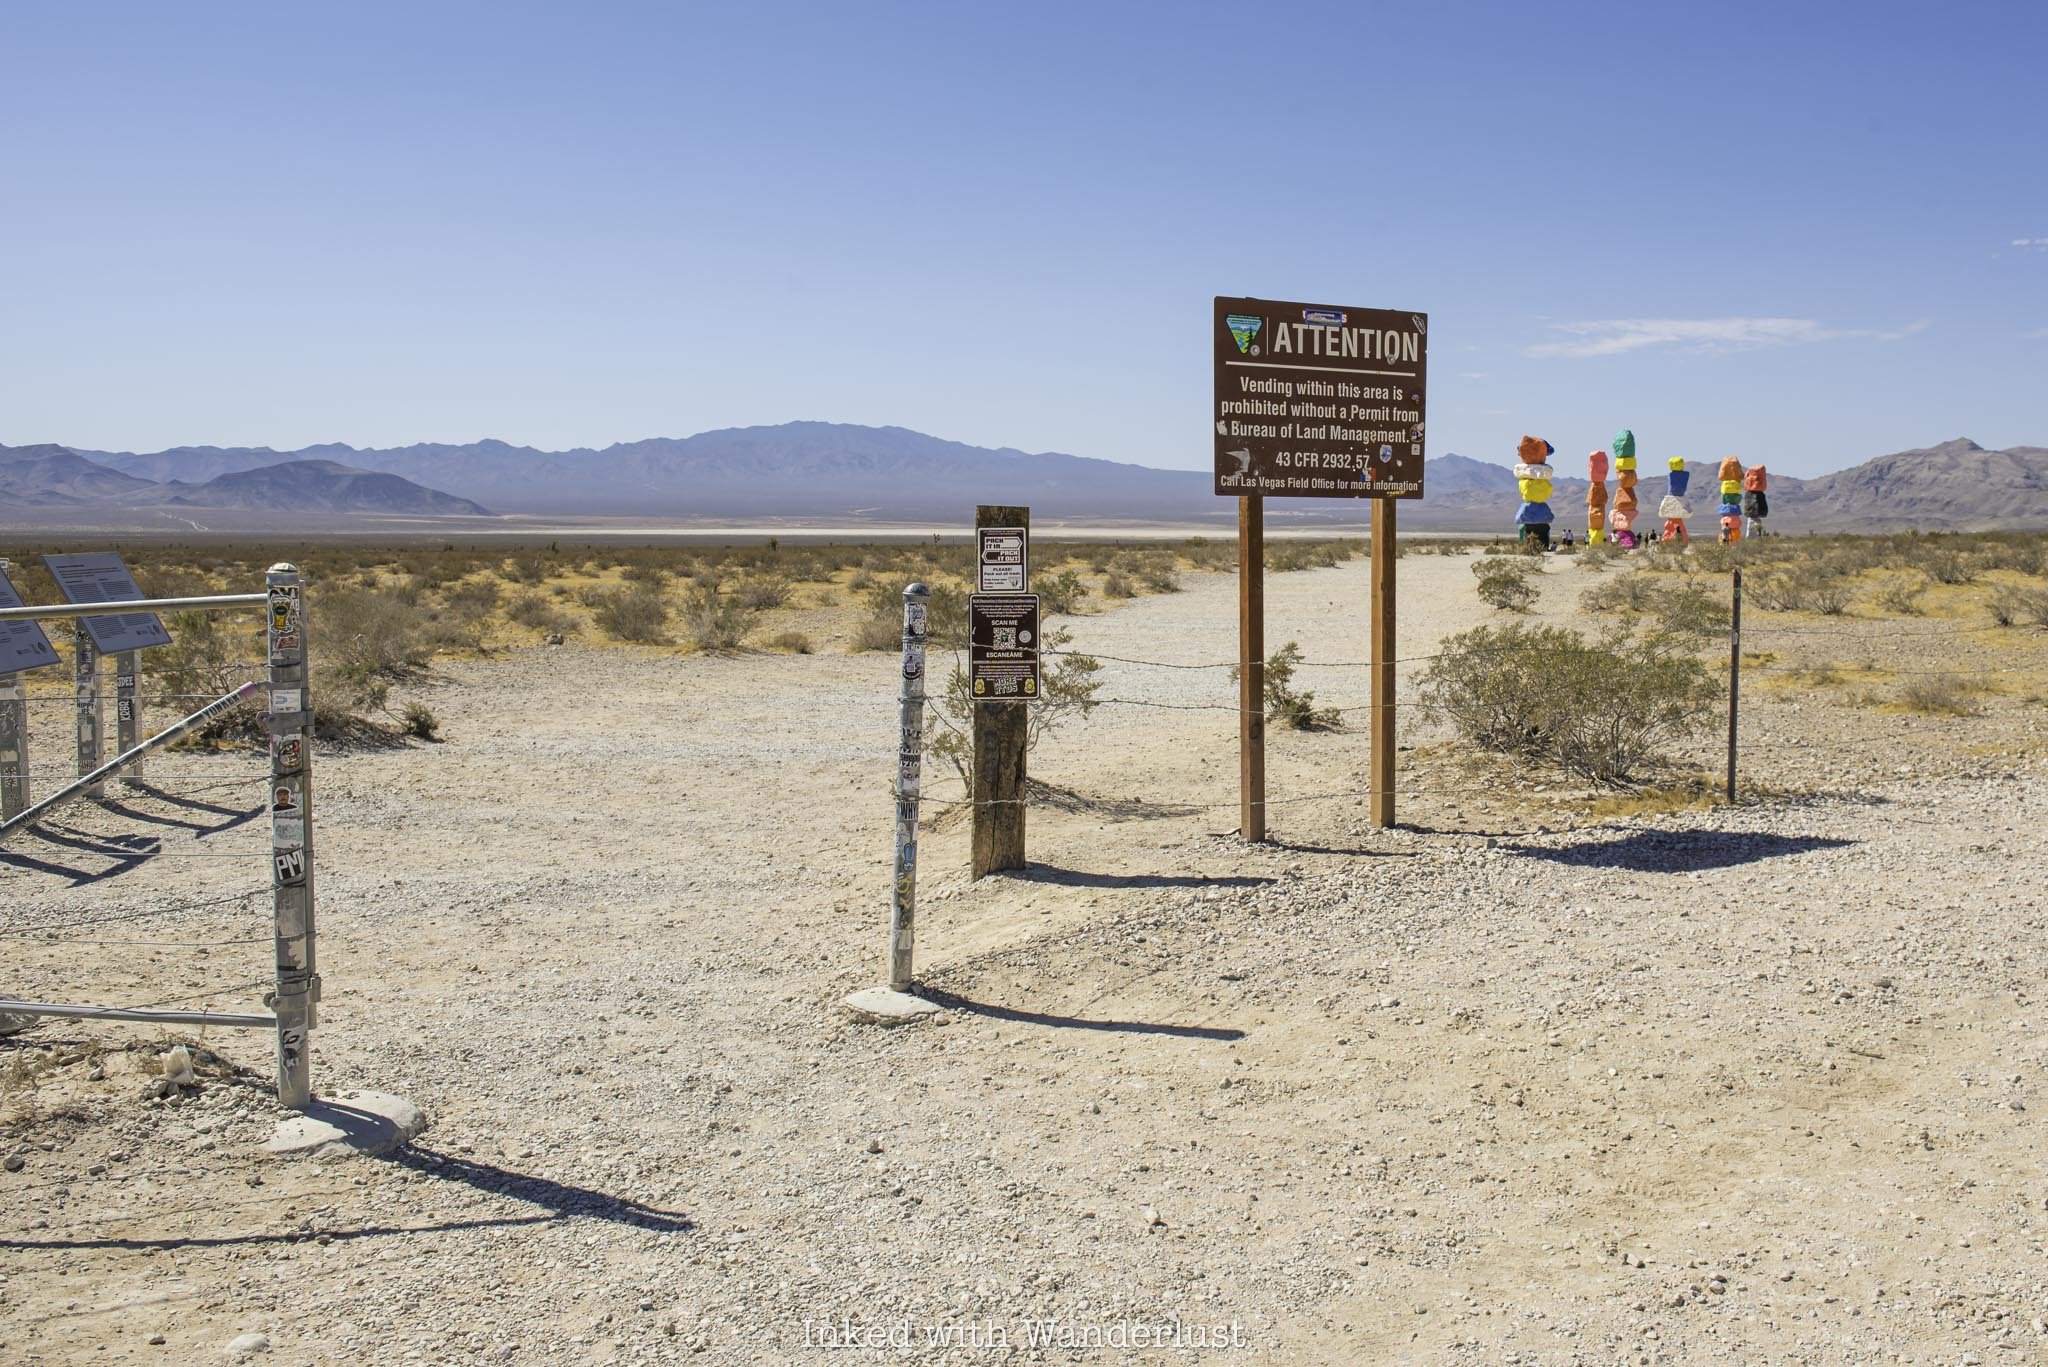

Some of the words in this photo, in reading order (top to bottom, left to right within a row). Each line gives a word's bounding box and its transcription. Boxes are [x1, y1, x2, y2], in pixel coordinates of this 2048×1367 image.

[1273, 321, 1419, 363] ATTENTION
[1240, 376, 1293, 397] Vending
[1296, 381, 1334, 397] within
[1338, 382, 1360, 398] this
[1363, 387, 1389, 400] area
[1393, 385, 1403, 400] is
[1221, 400, 1287, 416] prohibited
[1291, 402, 1336, 419] without
[1339, 406, 1347, 419] a
[1351, 404, 1389, 421] Permit
[1392, 406, 1419, 423] from
[1231, 420, 1276, 438] Bureau
[1280, 423, 1293, 438] of
[1296, 423, 1326, 440] Land
[1330, 425, 1410, 445] Management.
[1276, 451, 1291, 467] 43
[1294, 452, 1319, 468] CFR
[1322, 453, 1370, 470] 2932.57
[1241, 476, 1257, 487] Las
[1258, 476, 1286, 490] Vegas
[1287, 477, 1309, 489] Field
[1311, 477, 1335, 489] Office
[1337, 478, 1349, 490] for
[1351, 481, 1371, 490] more
[1373, 480, 1418, 491] information
